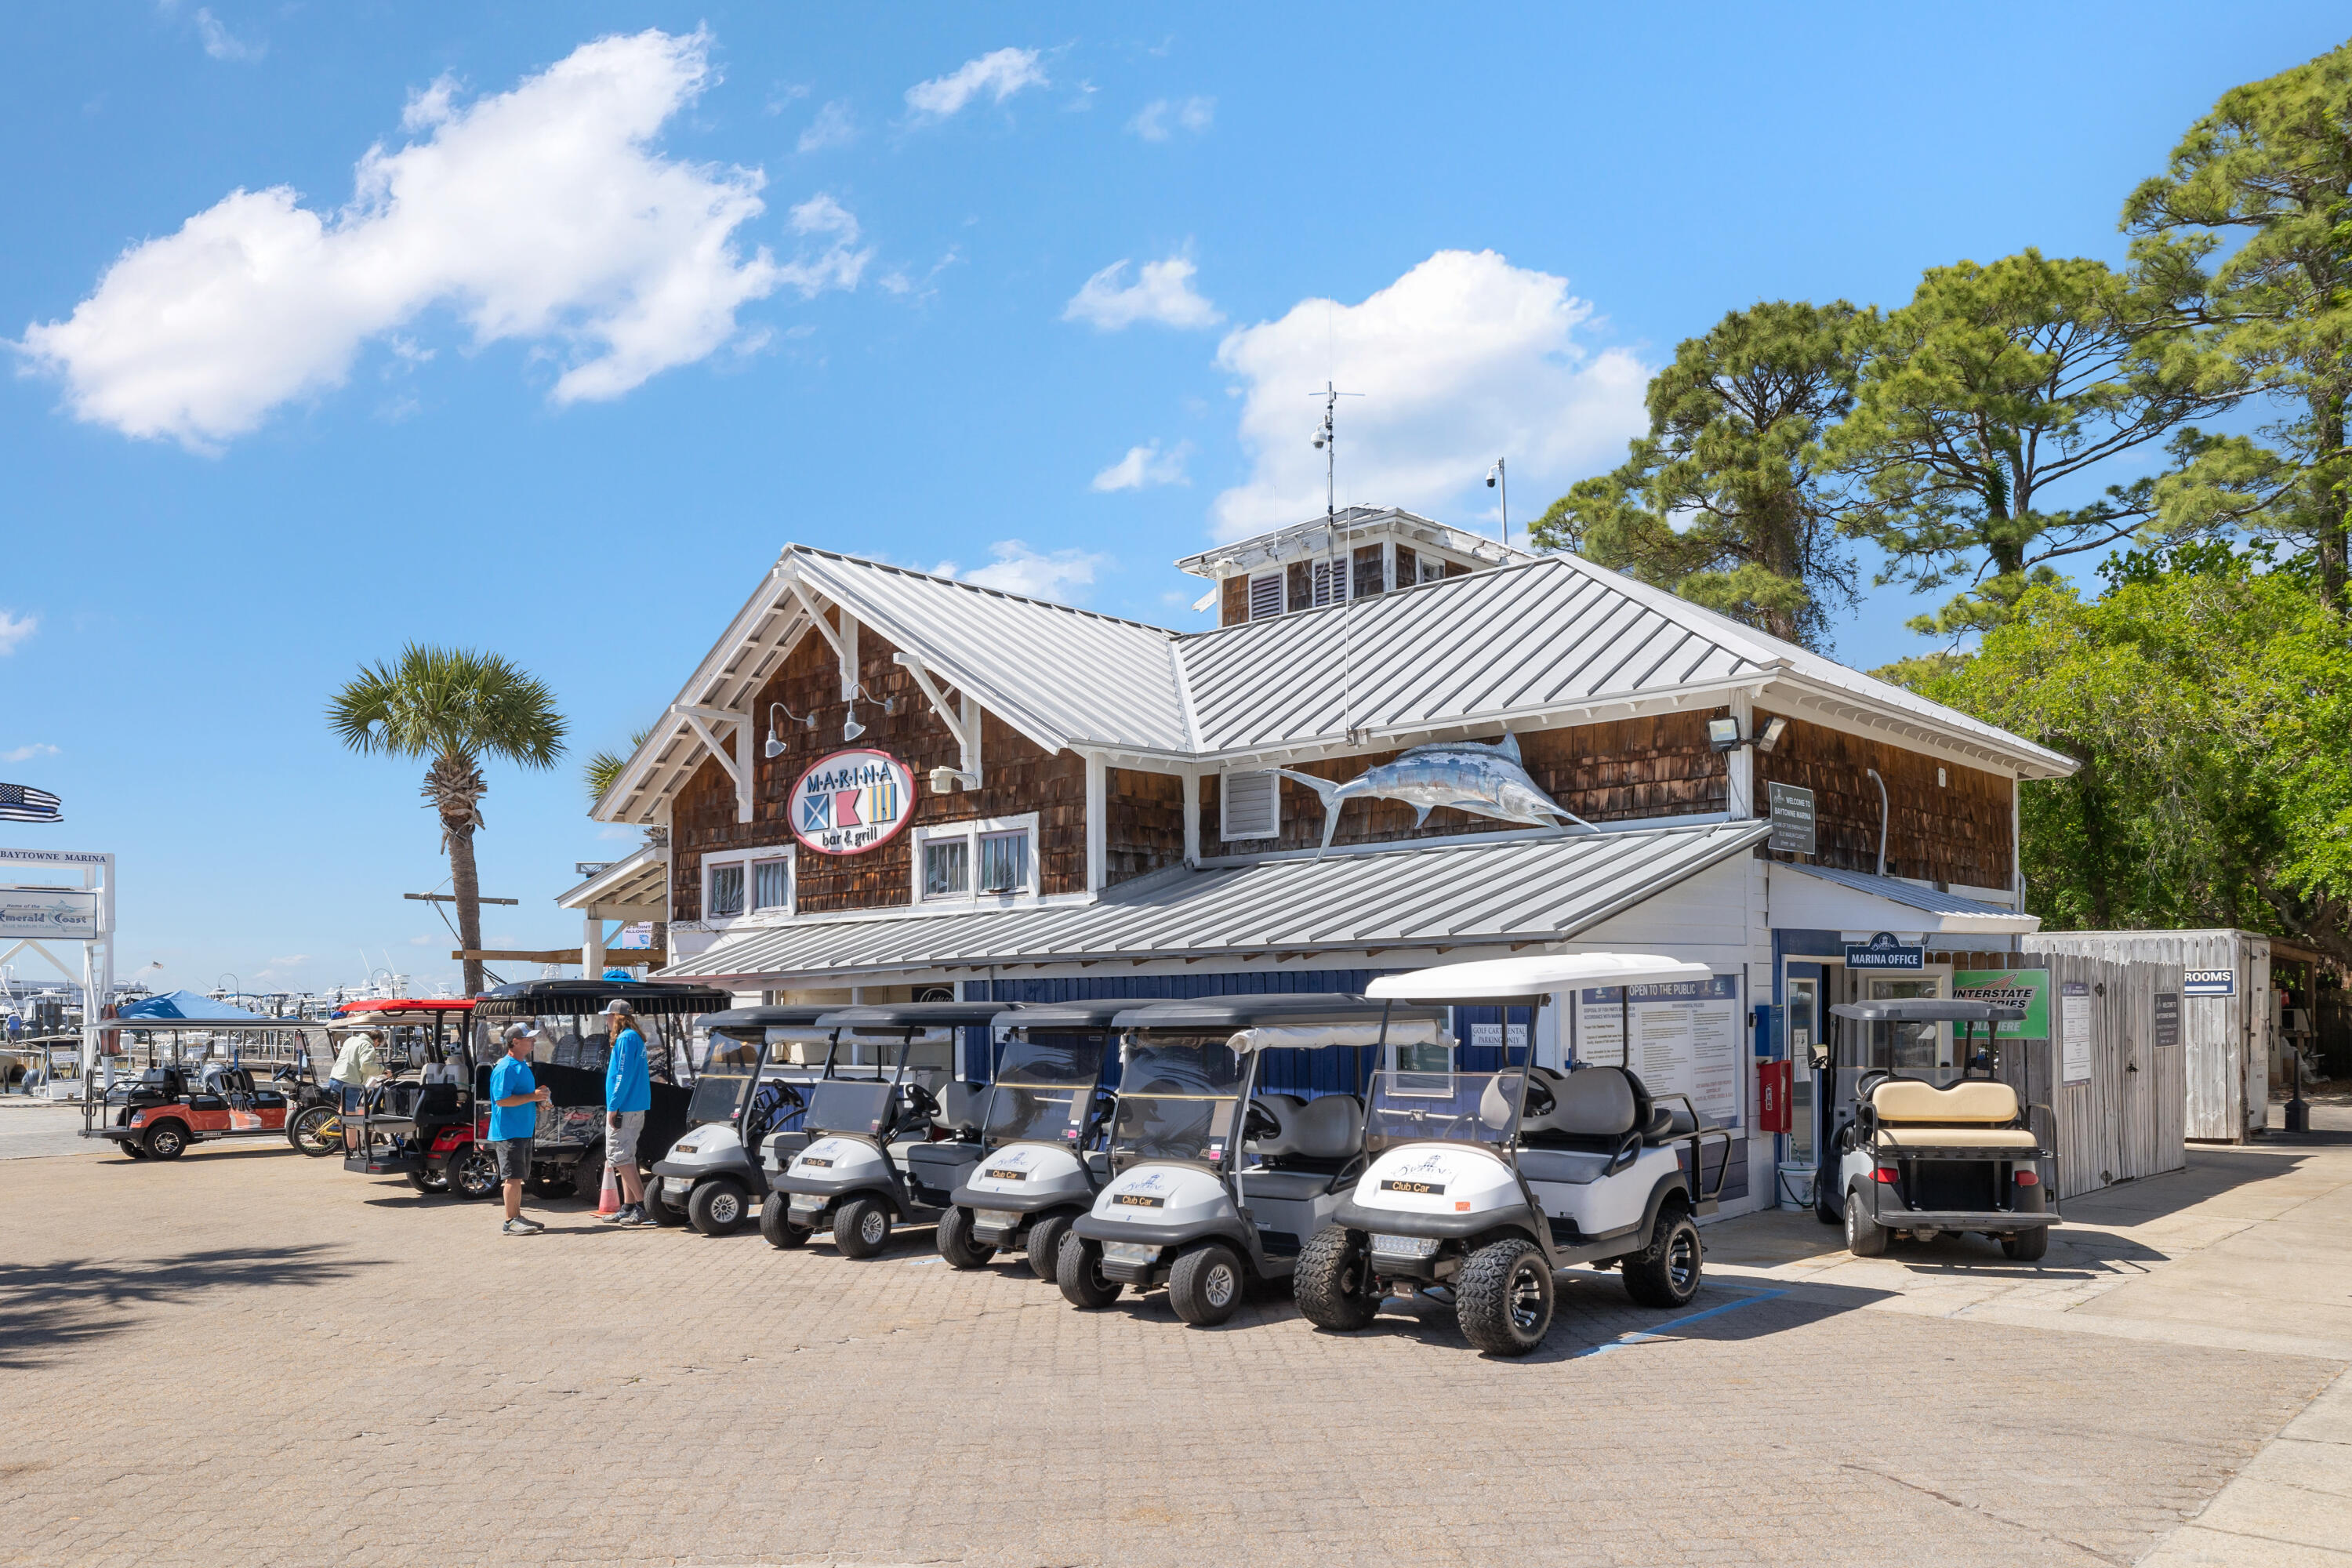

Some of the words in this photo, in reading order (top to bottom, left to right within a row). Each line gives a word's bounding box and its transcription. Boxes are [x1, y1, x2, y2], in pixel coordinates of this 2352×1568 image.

[1786, 796, 1805, 807] WELCOME
[1805, 800, 1811, 808] TO
[1774, 807, 1796, 818] BAYTOWNE
[1796, 811, 1812, 821] MARINA
[822, 833, 841, 847] bar
[844, 829, 852, 844] &
[855, 826, 877, 847] grill
[1, 851, 60, 860] BAYTOWNE
[65, 854, 107, 862] MARINA
[54, 913, 87, 924] Coast
[1851, 953, 1886, 964] MARINA
[1888, 954, 1918, 964] OFFICE
[1628, 984, 1648, 996] OPEN
[1649, 985, 1657, 996] TO
[1660, 984, 1672, 995] THE
[1674, 983, 1696, 995] PUBLIC
[1953, 989, 2033, 998] INTERSTATE
[993, 1170, 1005, 1178] Club
[1392, 1181, 1411, 1191] Club
[1414, 1182, 1430, 1192] Car
[1122, 1196, 1138, 1205] Club
[1139, 1196, 1152, 1206] Car
